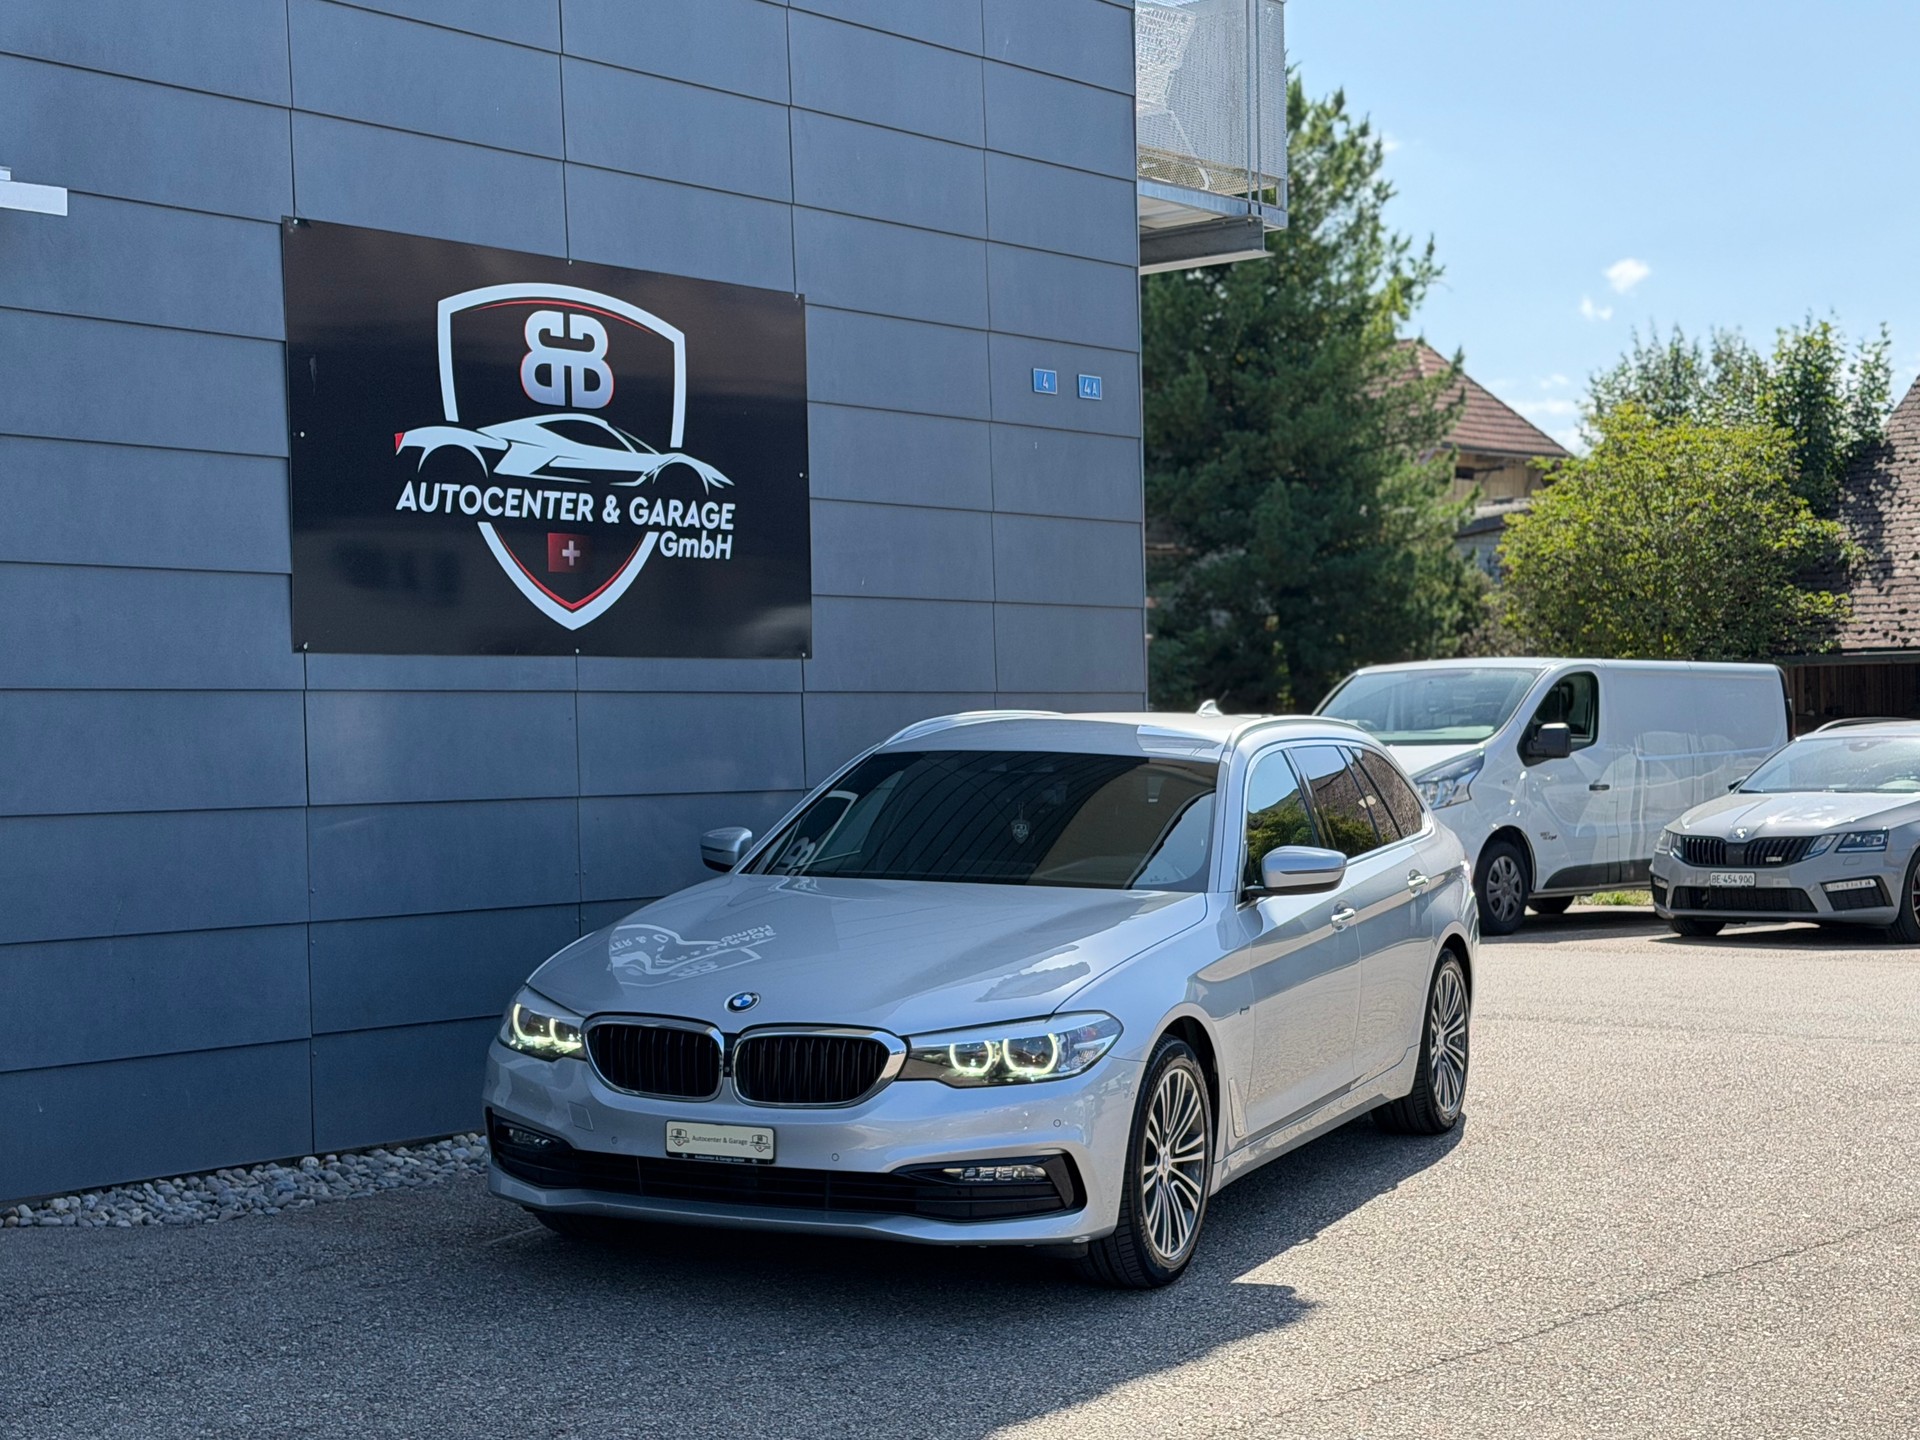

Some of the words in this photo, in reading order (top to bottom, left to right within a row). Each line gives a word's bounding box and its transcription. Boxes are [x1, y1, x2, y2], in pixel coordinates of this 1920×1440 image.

[1042, 372, 1049, 390] 4
[396, 481, 594, 523] AUTOCENTER
[602, 494, 621, 523] &
[629, 497, 736, 531] GARAGE
[659, 530, 734, 561] GmbH
[1711, 874, 1721, 884] BE
[692, 1135, 722, 1143] Autocenter
[729, 1137, 748, 1146] Garage
